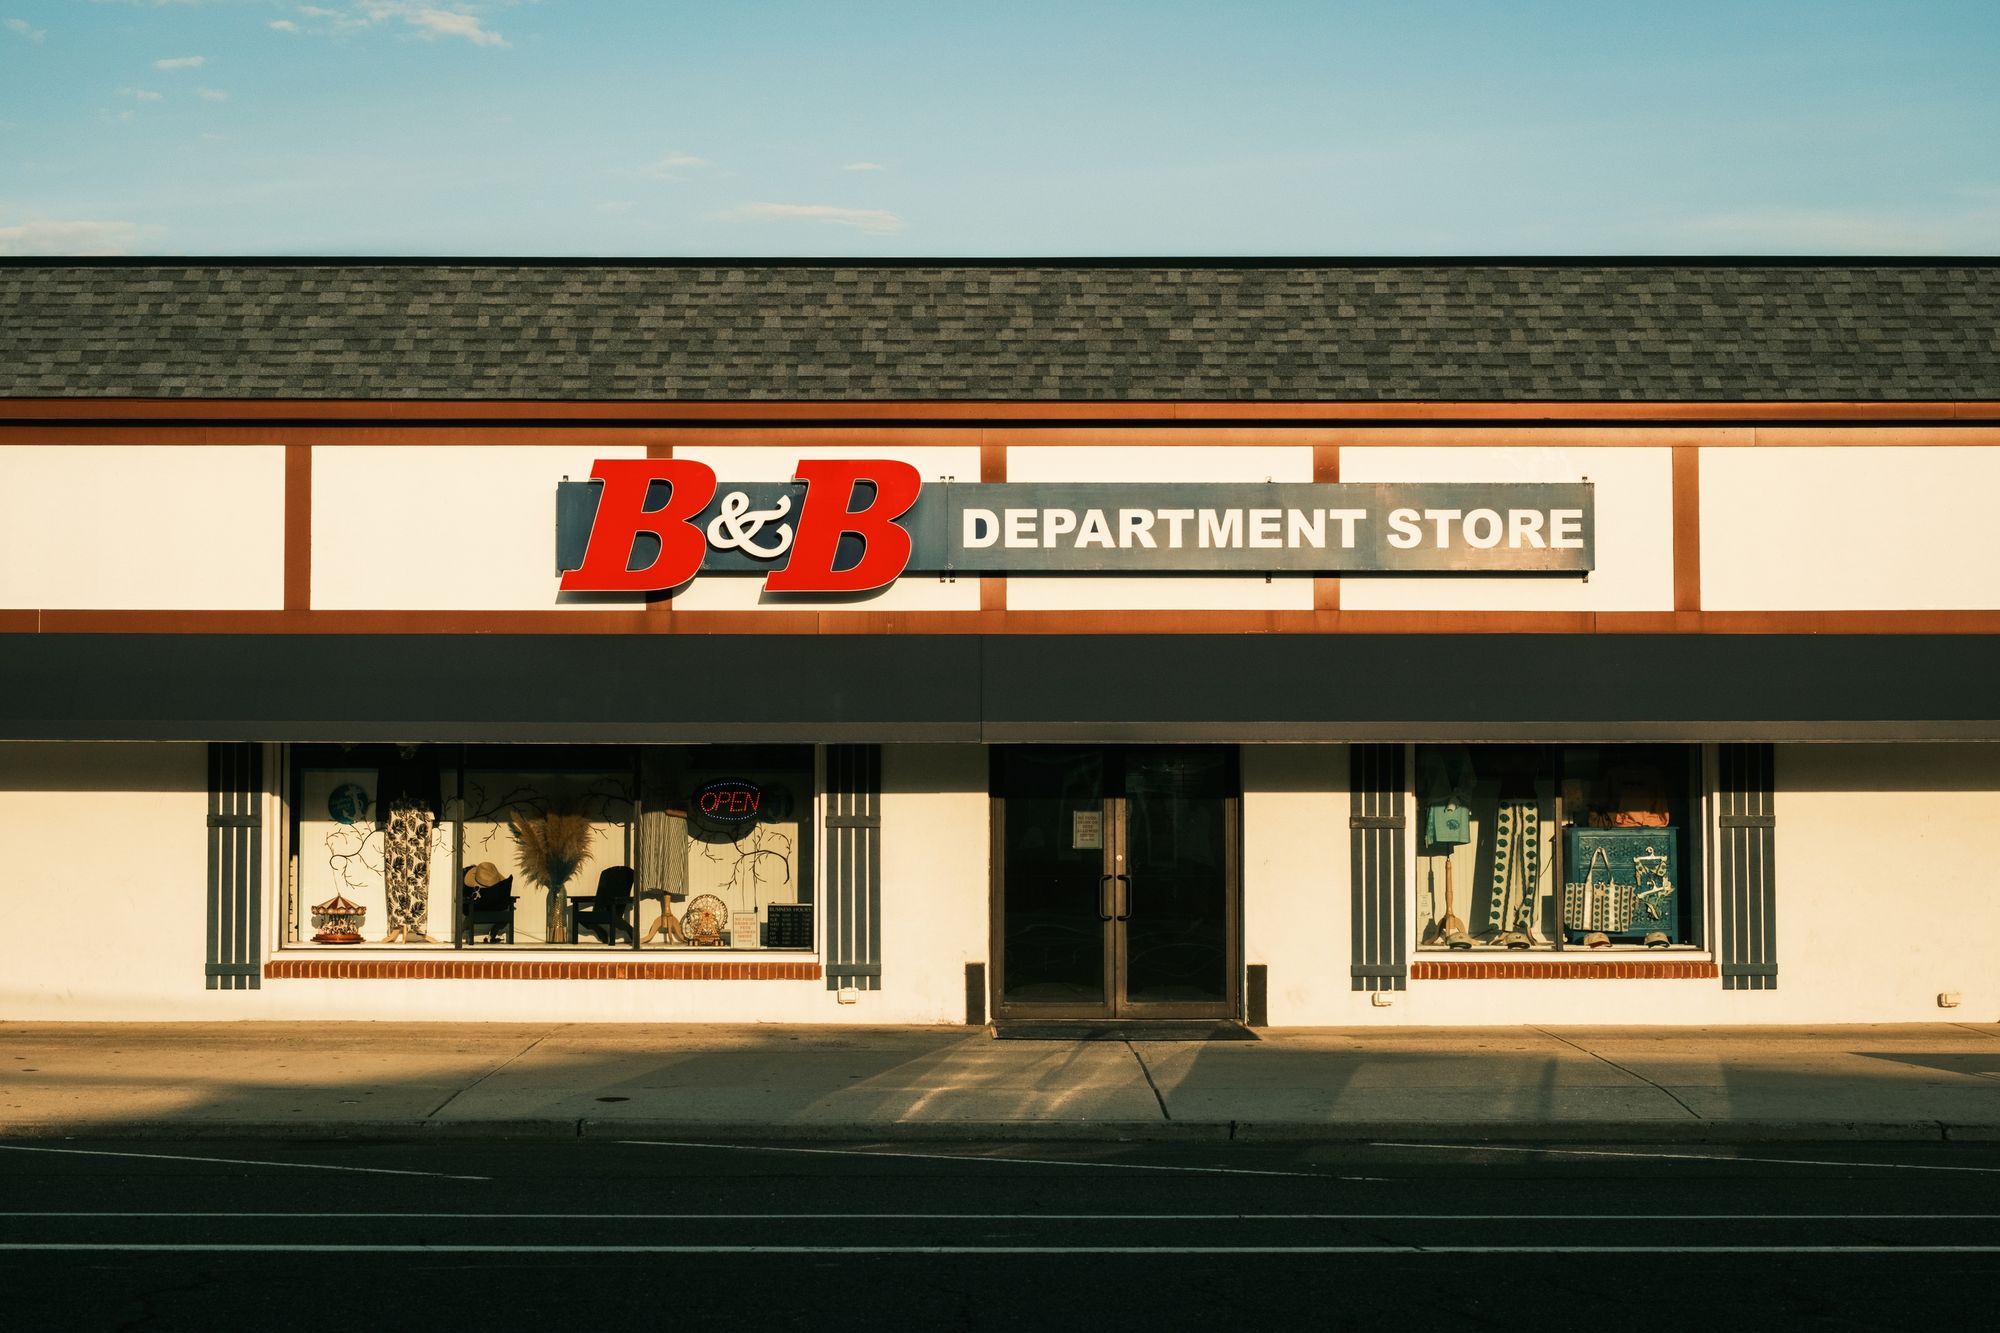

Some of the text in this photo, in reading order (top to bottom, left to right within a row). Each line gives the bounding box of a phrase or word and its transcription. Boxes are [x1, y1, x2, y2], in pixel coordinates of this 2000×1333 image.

[559, 459, 1584, 592] B&B DEPARTMENT STORE
[700, 791, 760, 812] OPEN
